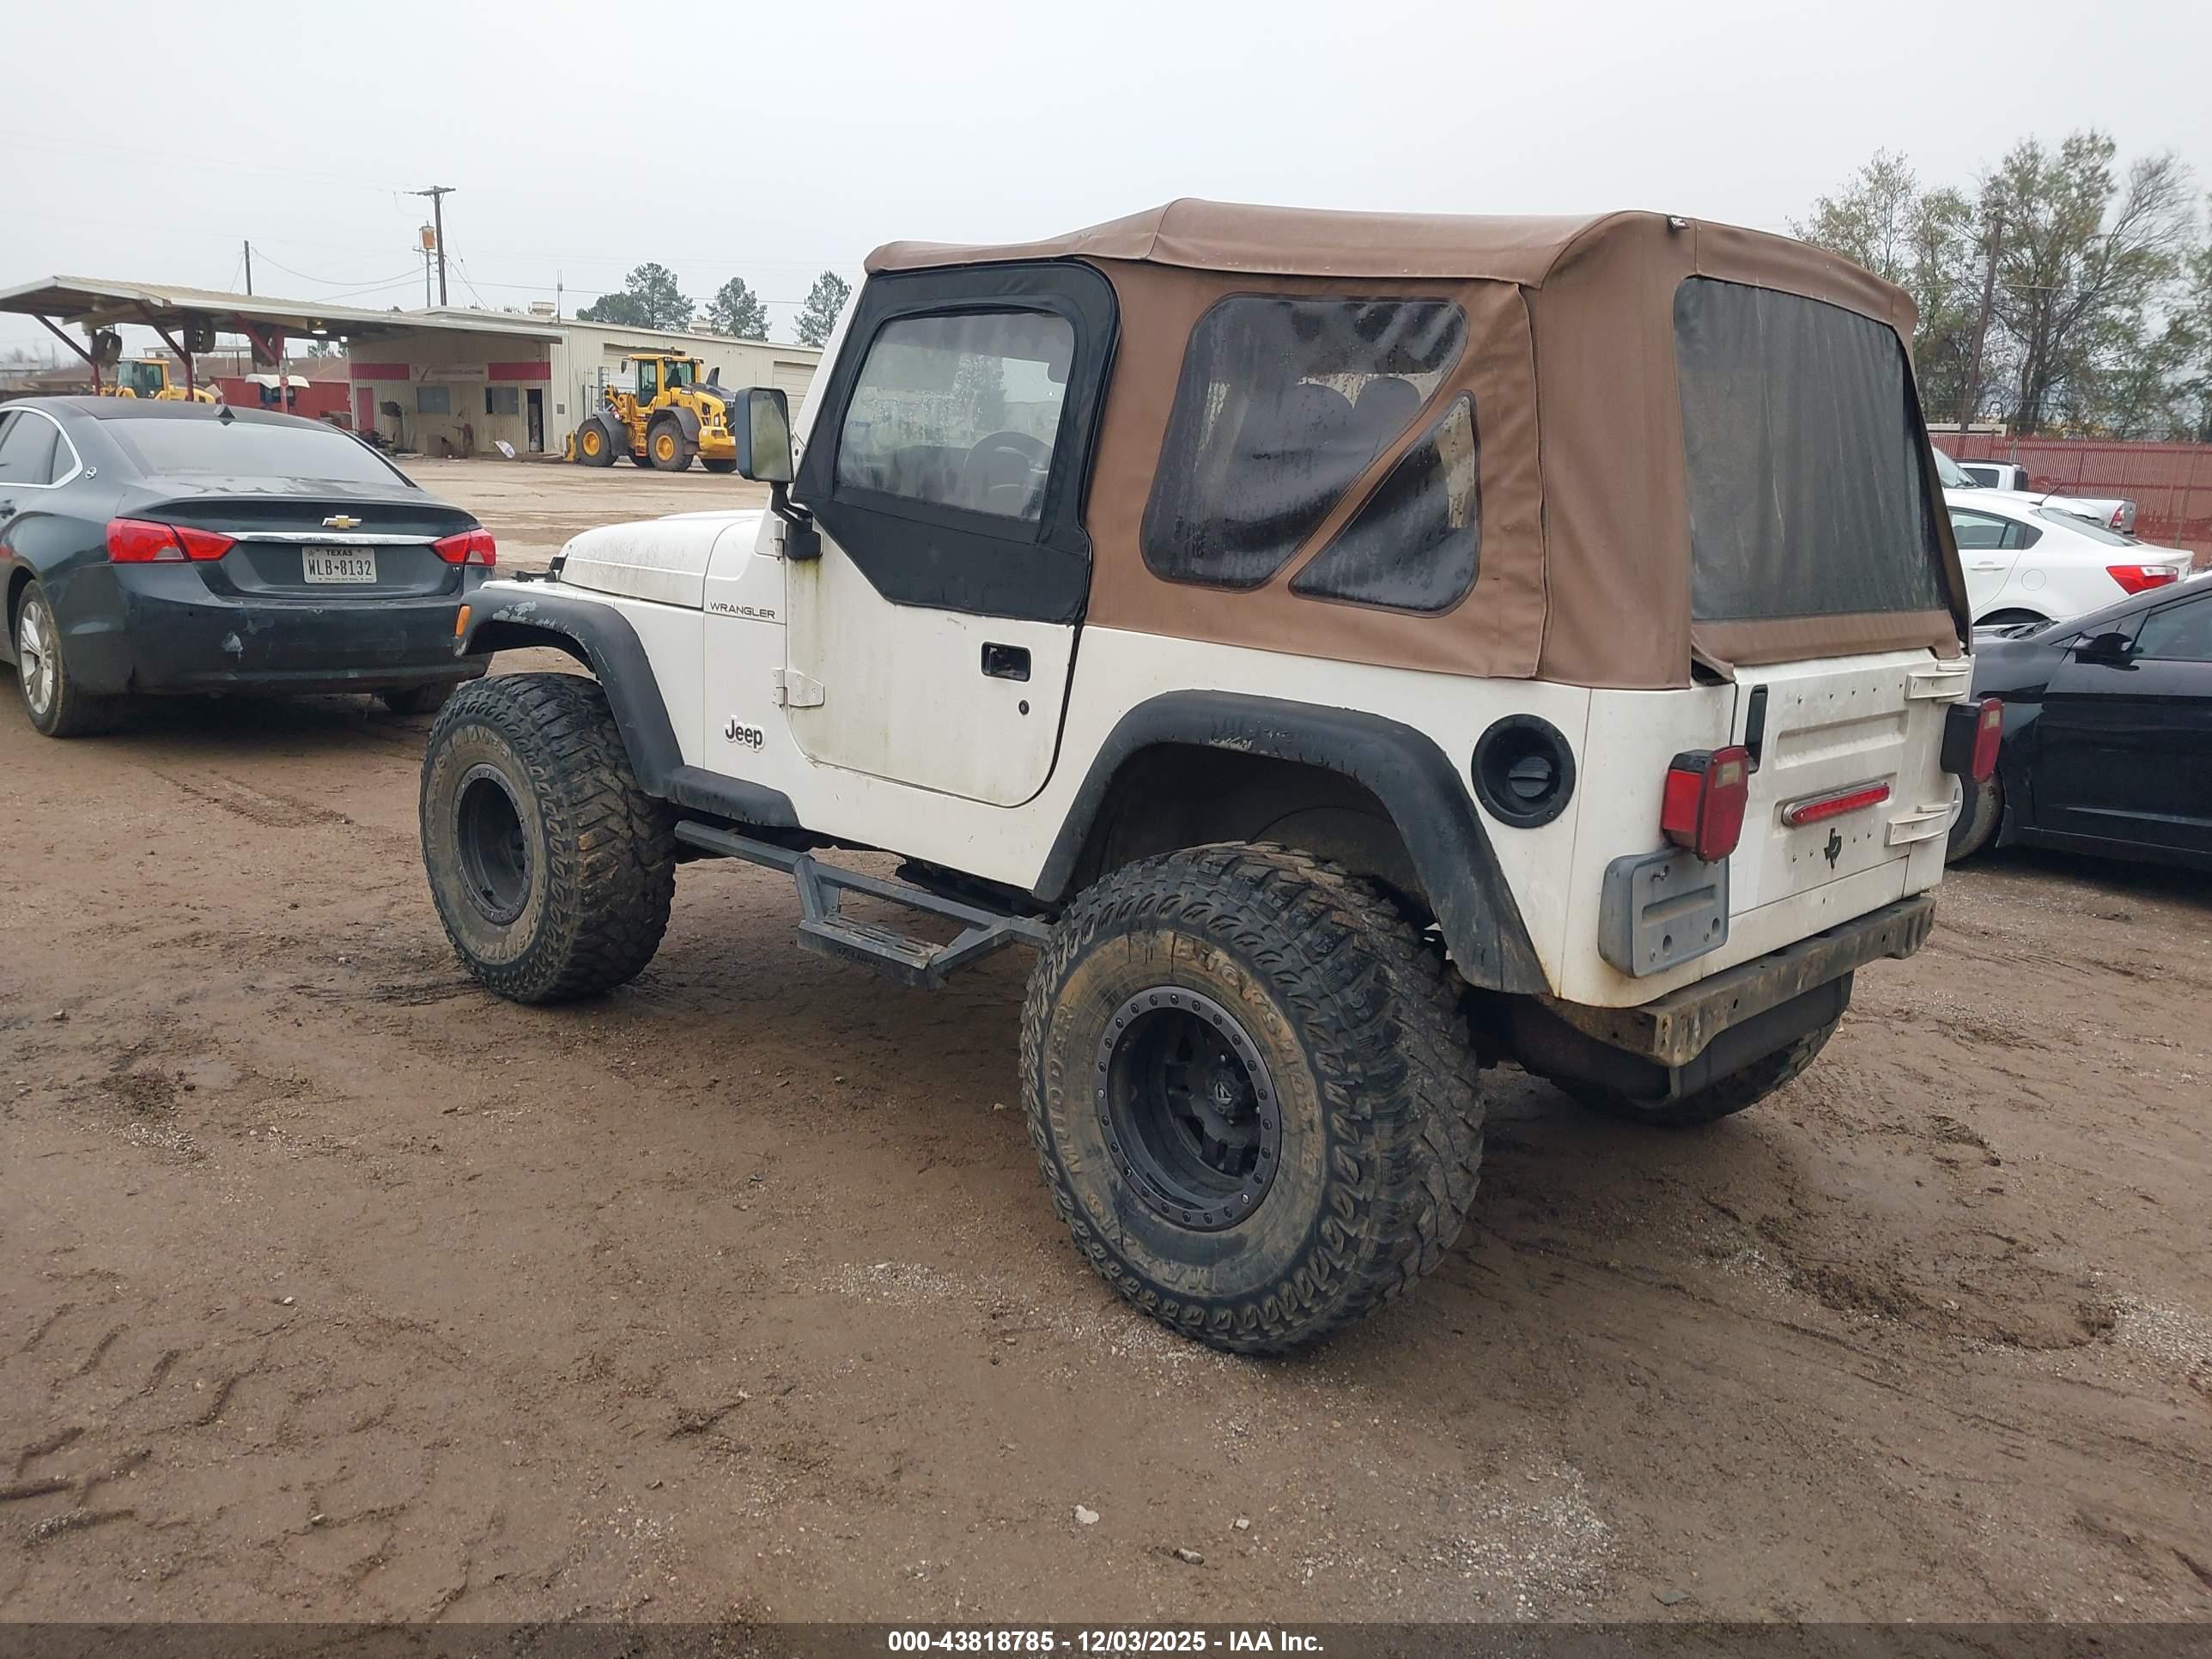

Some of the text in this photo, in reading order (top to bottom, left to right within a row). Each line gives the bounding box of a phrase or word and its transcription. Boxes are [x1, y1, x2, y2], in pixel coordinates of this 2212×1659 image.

[340, 560, 372, 576] 8132
[709, 601, 776, 619] WRANGLER
[725, 719, 763, 750] Jeep
